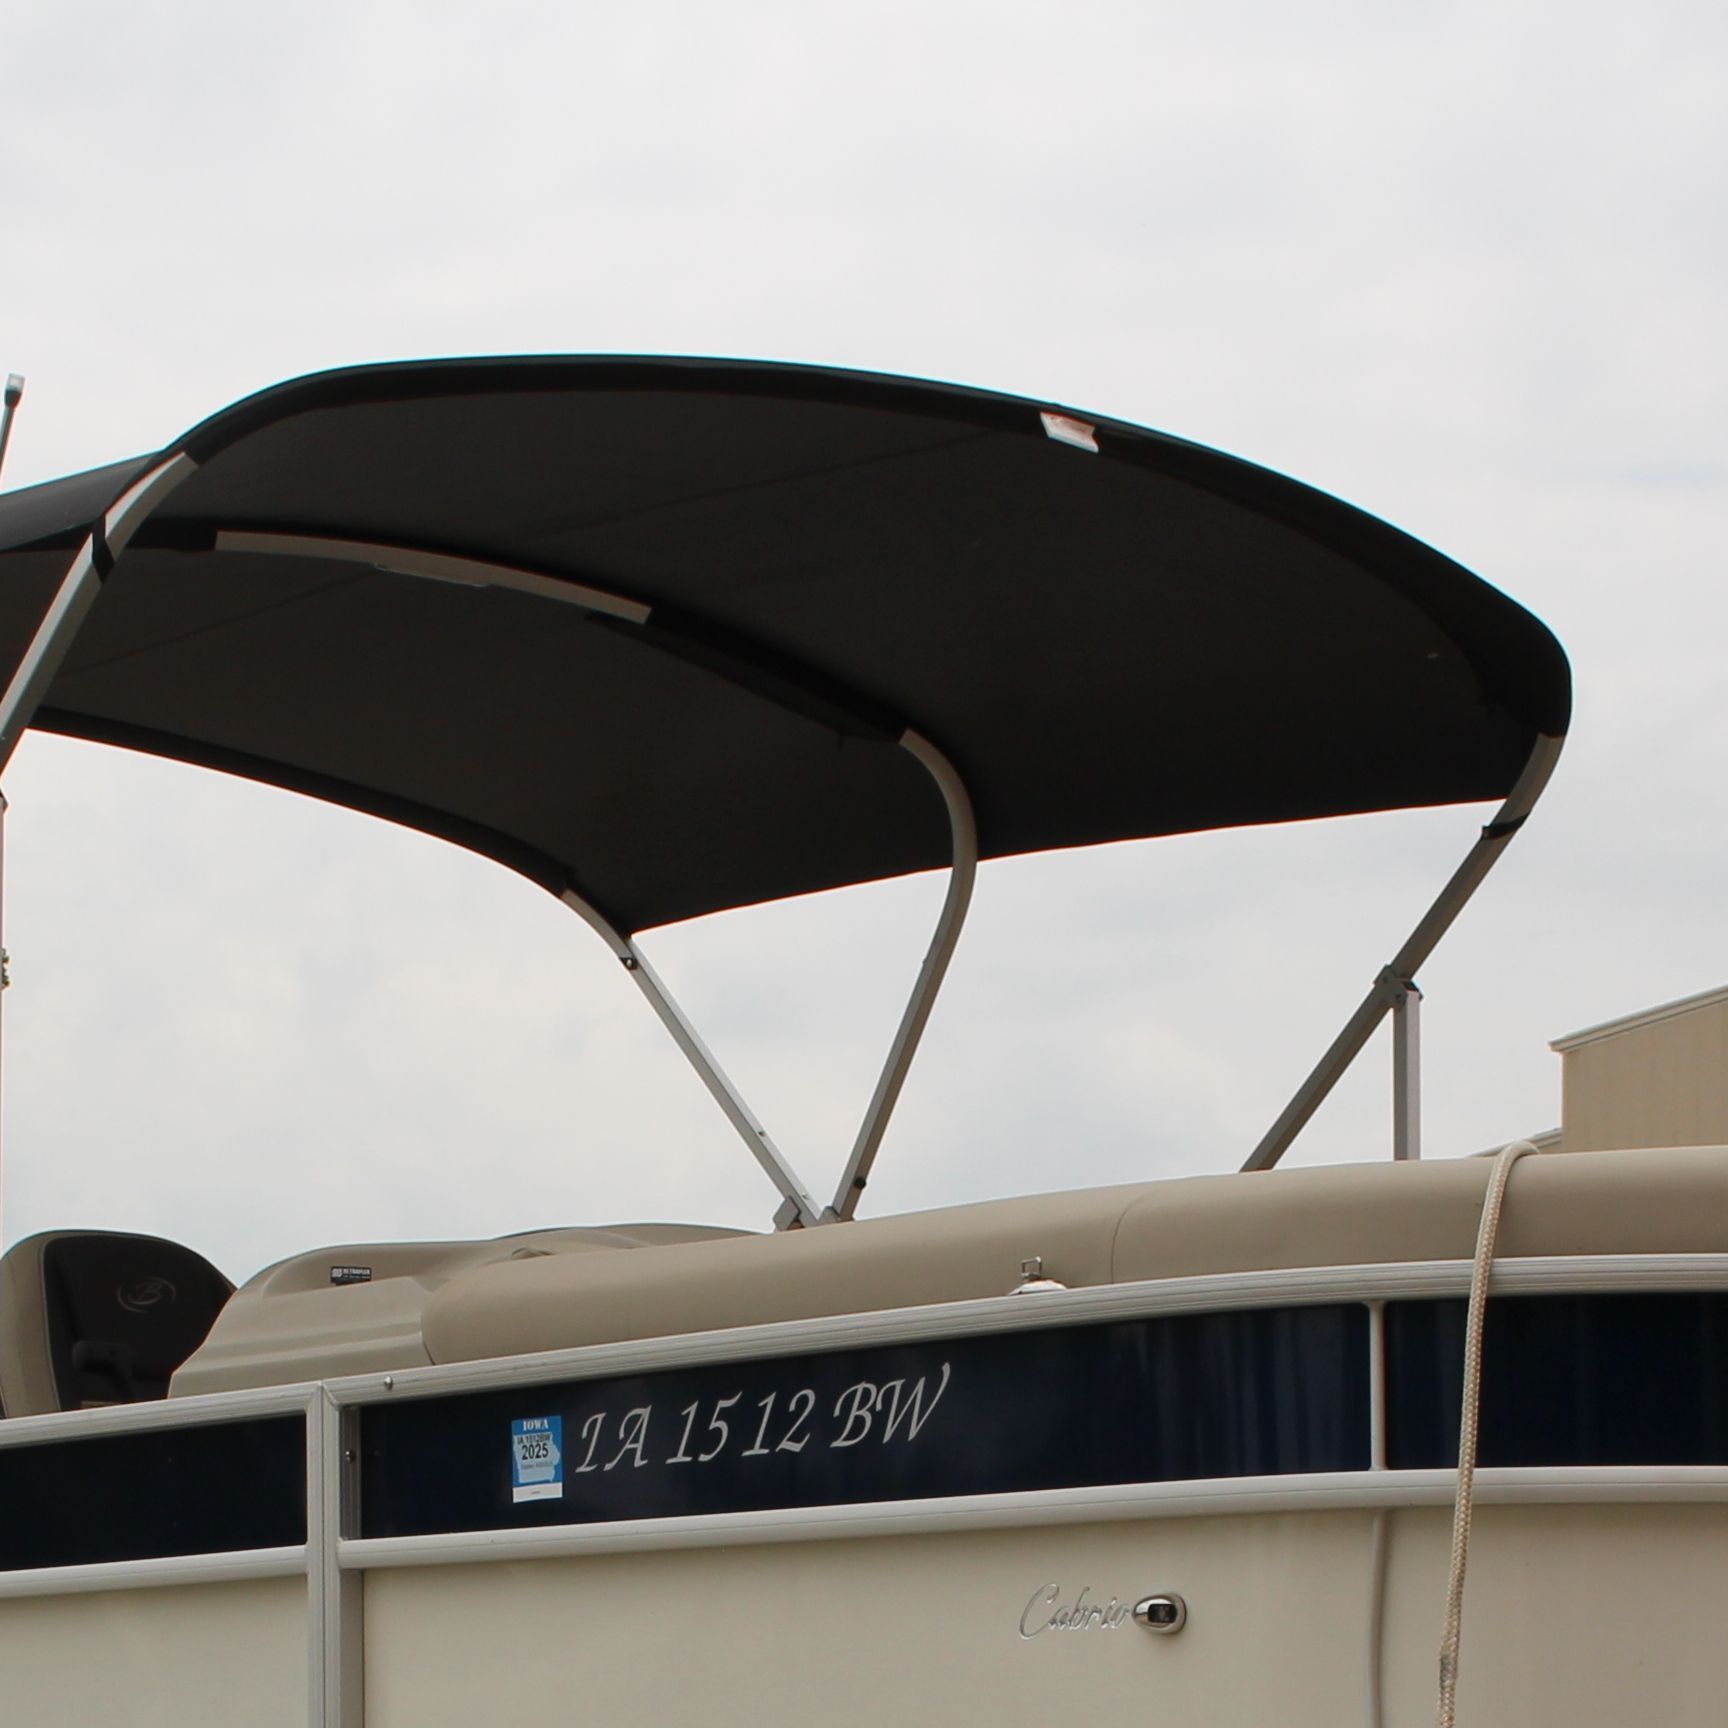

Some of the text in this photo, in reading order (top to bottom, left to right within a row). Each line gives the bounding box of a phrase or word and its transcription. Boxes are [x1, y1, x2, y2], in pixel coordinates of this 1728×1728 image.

[523, 1419, 549, 1431] IOWA
[575, 1404, 652, 1473] IA
[831, 1362, 951, 1448] BW
[521, 1443, 549, 1460] 2025
[1019, 1583, 1131, 1640] Cabrio
